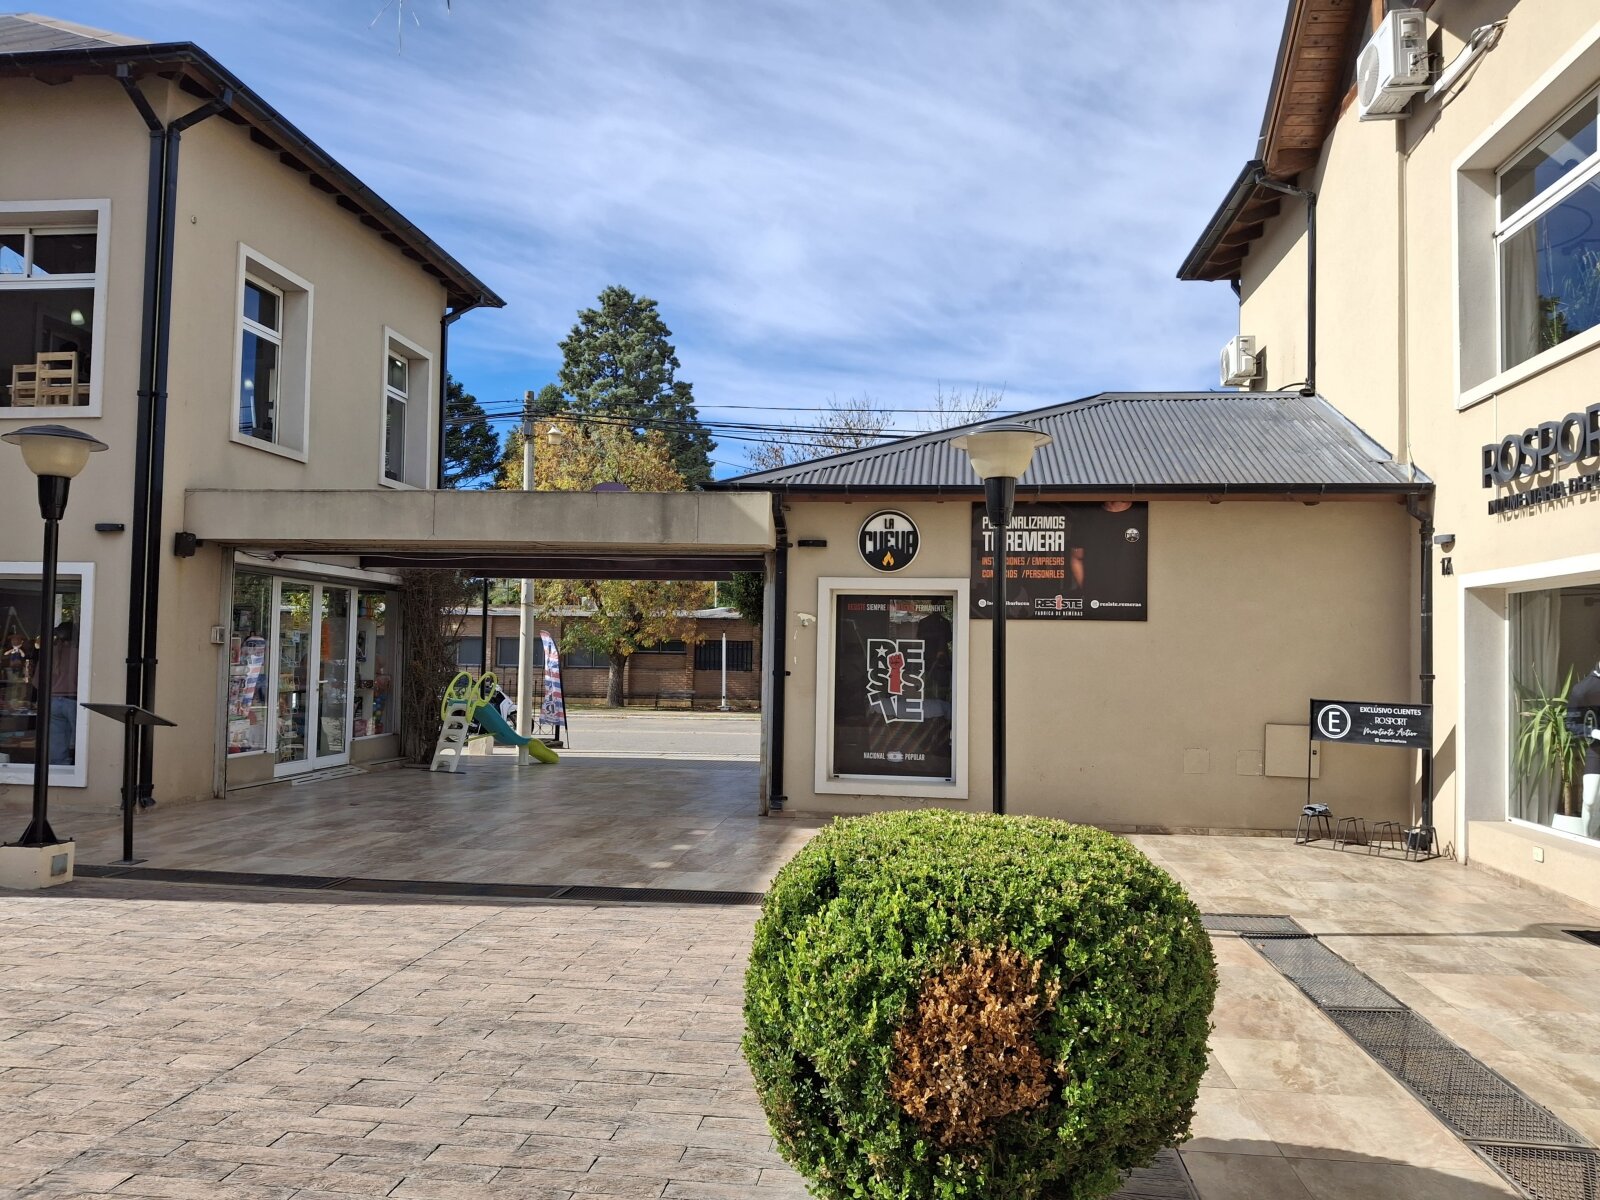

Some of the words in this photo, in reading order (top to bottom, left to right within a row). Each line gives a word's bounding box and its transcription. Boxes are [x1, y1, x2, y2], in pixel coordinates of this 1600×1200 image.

[884, 518, 895, 530] LA
[864, 530, 916, 555] CUEVA
[1006, 531, 1065, 552] REMERA
[1031, 556, 1065, 566] EMPRESAS
[866, 603, 887, 612] SIEMPRE
[915, 604, 946, 612] PERMANENTE
[1360, 706, 1392, 715] EXCLUSIVO
[1393, 708, 1422, 716] CLIENTES
[1328, 711, 1341, 733] E
[1374, 716, 1407, 726] ROSPORT
[904, 753, 926, 761] POPULAR
